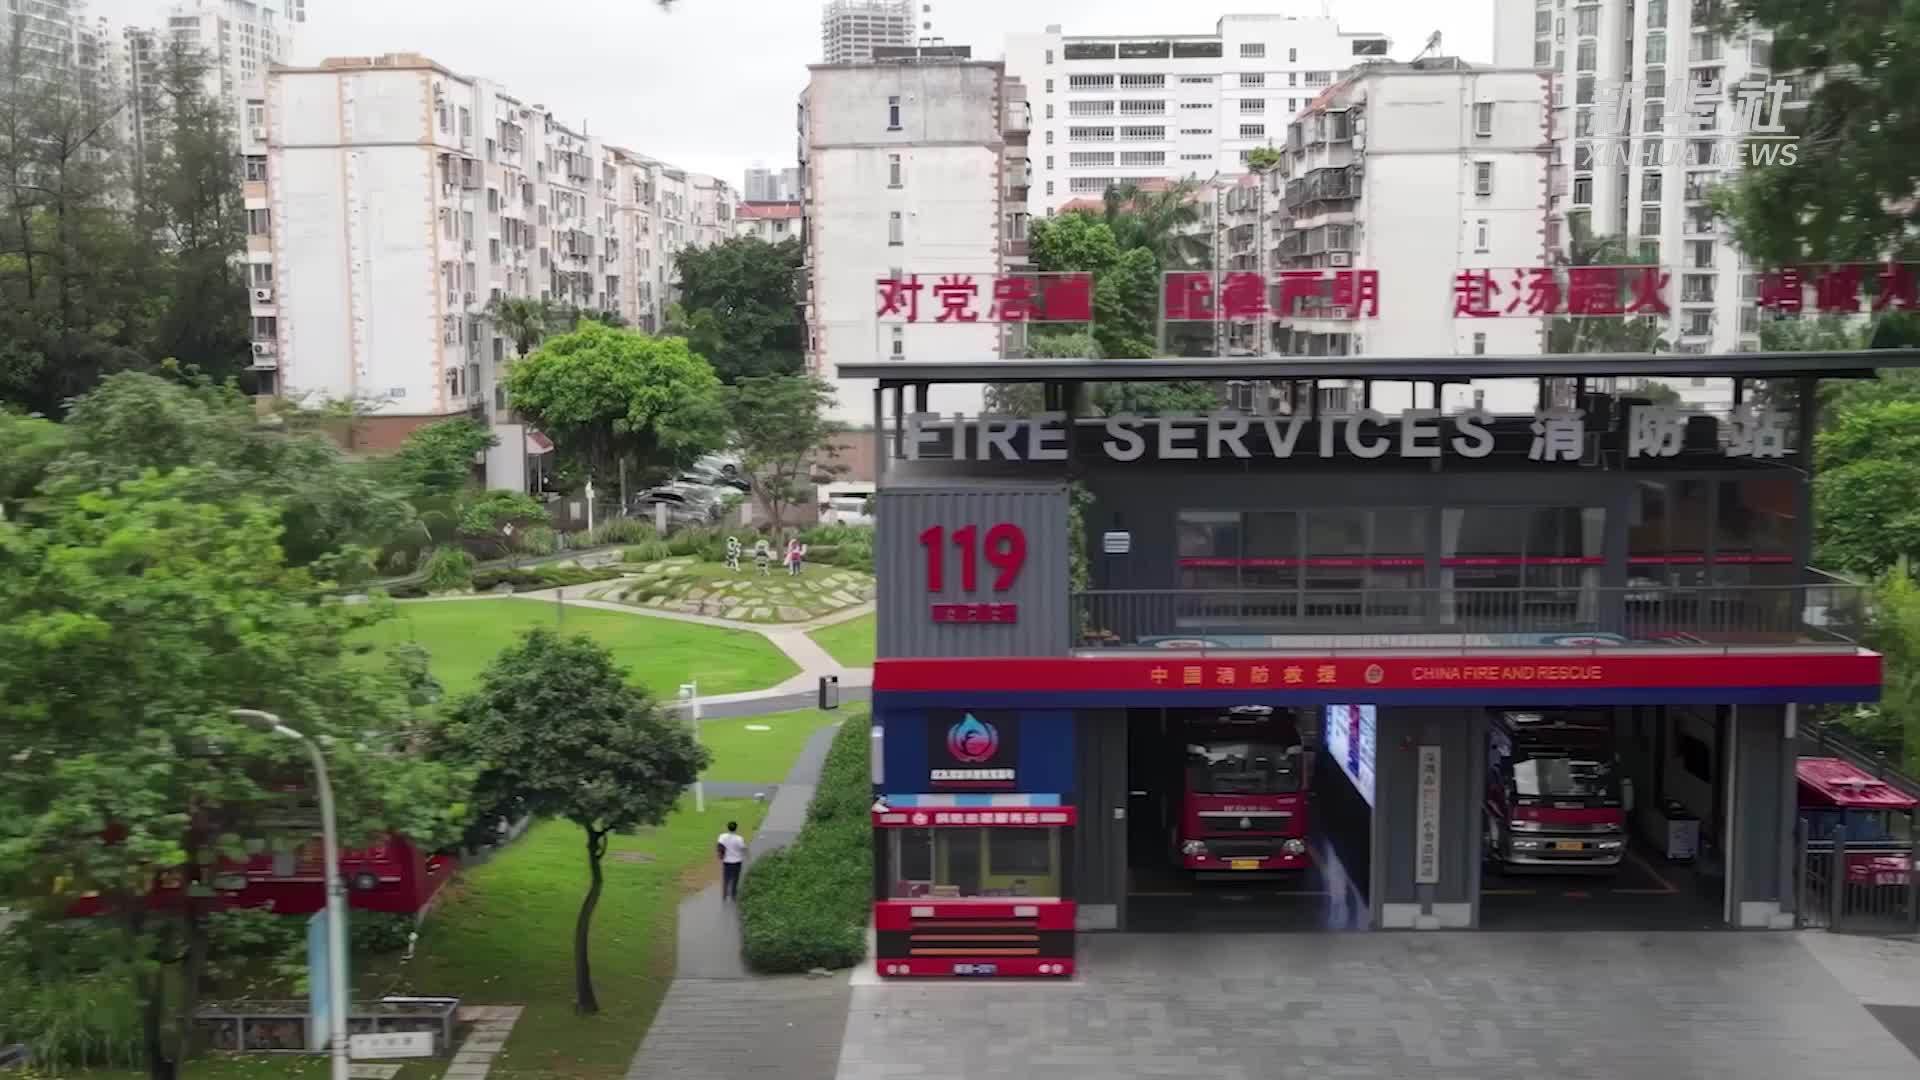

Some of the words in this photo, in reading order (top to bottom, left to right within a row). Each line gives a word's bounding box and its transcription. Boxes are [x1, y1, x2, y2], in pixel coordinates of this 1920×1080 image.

[903, 411, 1069, 461] FIRE
[1102, 409, 1496, 461] SERVICES
[1528, 403, 1787, 461] 消防站
[919, 522, 1027, 592] 119
[1411, 665, 1461, 681] CHINA
[1463, 665, 1500, 681] FIRE
[1502, 665, 1535, 681] AND
[1536, 665, 1603, 681] RESCUE
